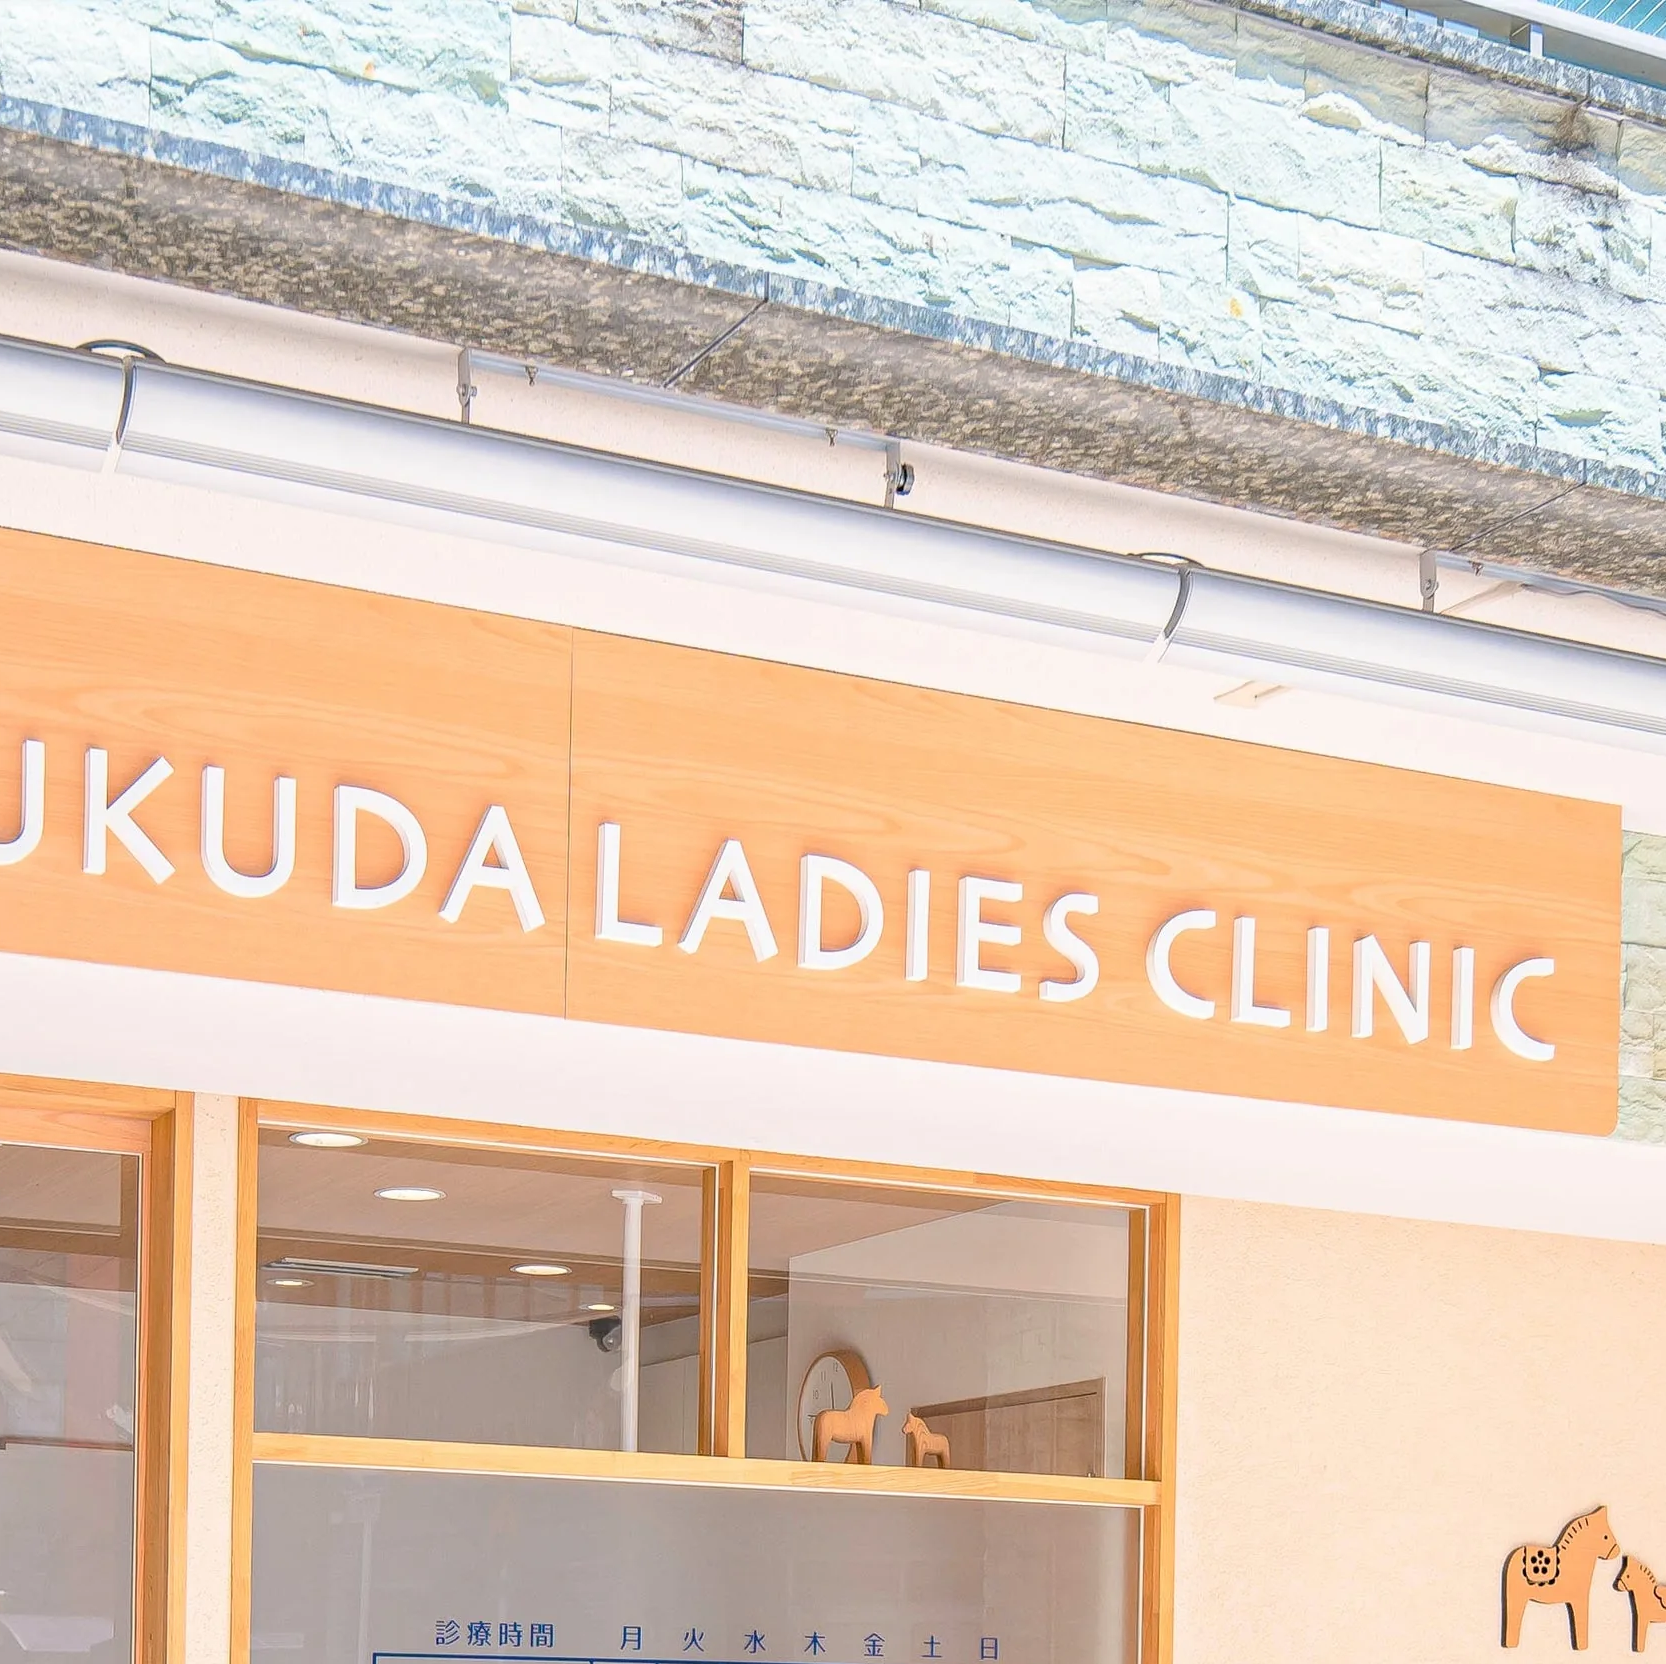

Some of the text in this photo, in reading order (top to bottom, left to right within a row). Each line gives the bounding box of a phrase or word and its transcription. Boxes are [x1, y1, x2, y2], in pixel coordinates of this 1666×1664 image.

[595, 821, 1100, 1002] LADIES
[1146, 908, 1555, 1062] CLINIC
[435, 1619, 999, 1660] 診療時間 月 火 水 木 金 土 日
